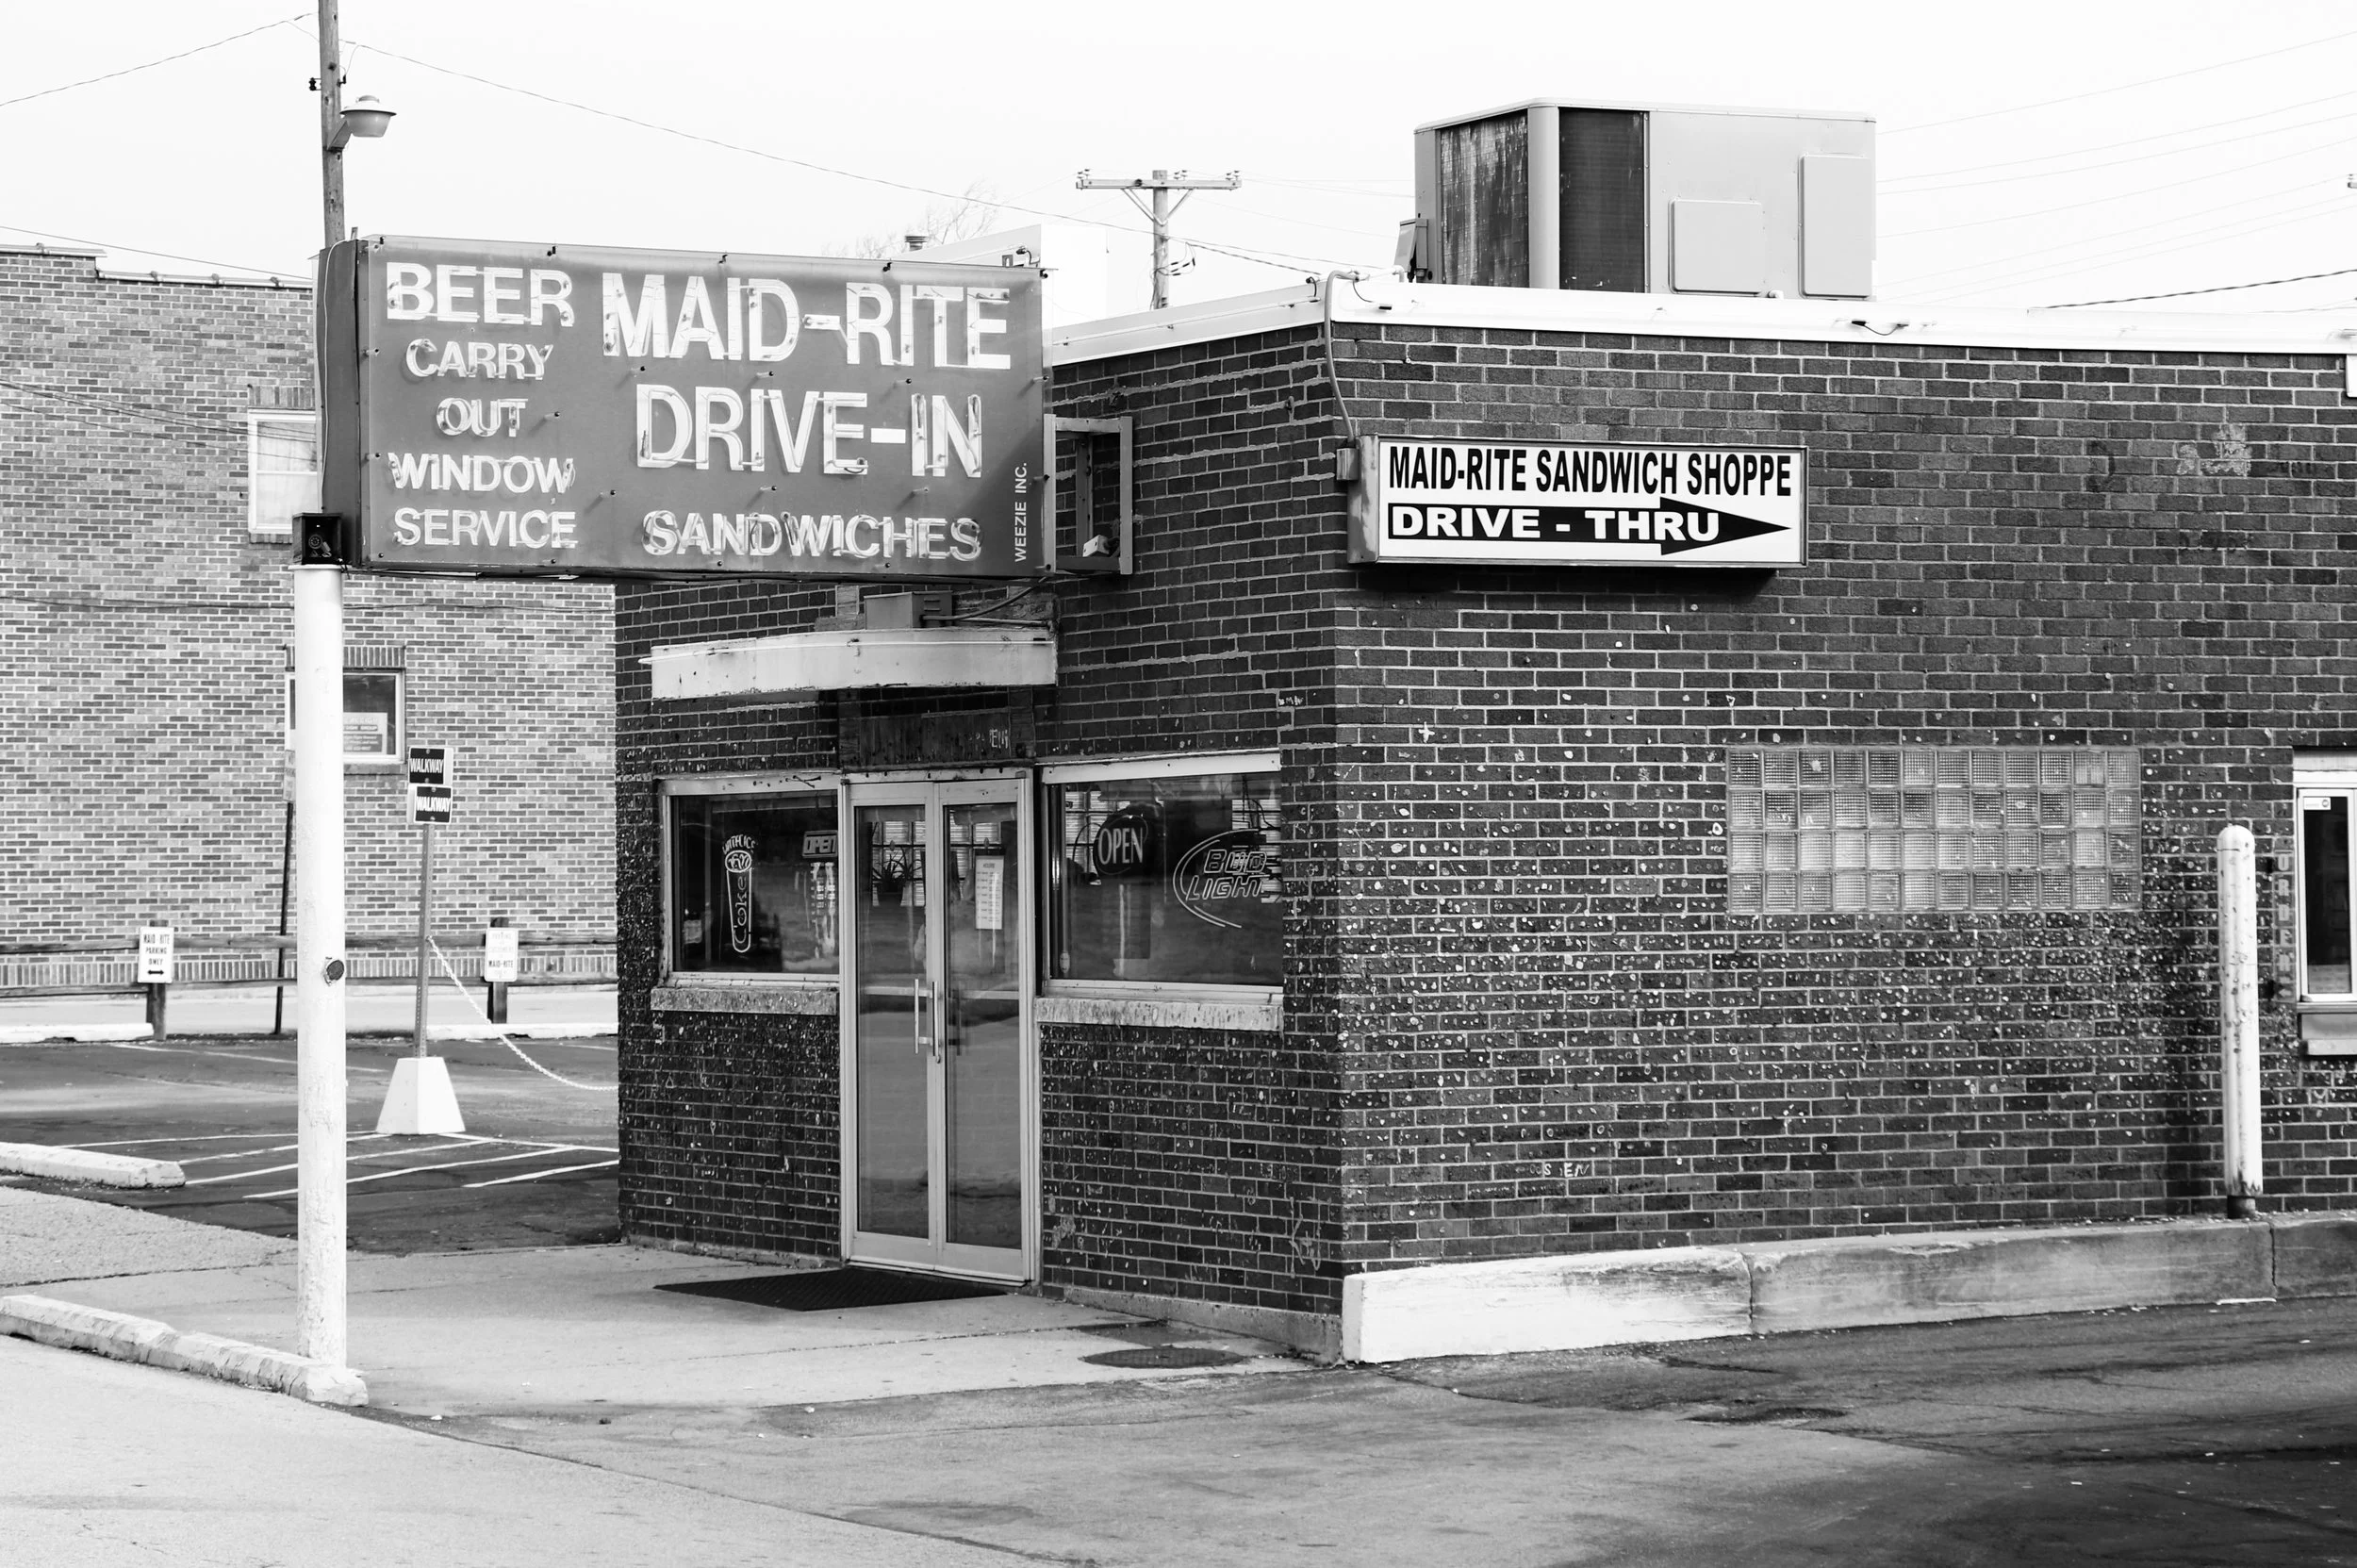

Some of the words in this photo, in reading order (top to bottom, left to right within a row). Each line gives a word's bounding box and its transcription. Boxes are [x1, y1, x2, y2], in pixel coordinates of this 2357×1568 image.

[387, 261, 575, 327] BEER
[602, 272, 1011, 370] MAID-RITE
[405, 338, 553, 380] CARRY
[436, 397, 528, 437] OUT
[636, 383, 982, 478] DRIVE-IN
[387, 452, 576, 494] WINDOW
[1014, 462, 1028, 494] INC.
[1390, 446, 1527, 491] MAID-RITE
[1536, 449, 1677, 494] SANDWICH
[1687, 453, 1791, 496] SHOPPE
[392, 507, 579, 550] SERVICE
[641, 510, 983, 563] SANDWICHES
[1014, 502, 1027, 562] WEEZIE
[1392, 505, 1541, 538] DRIVE
[1584, 510, 1720, 542] THRU
[408, 758, 444, 773] WALKWAY
[416, 796, 451, 812] WALKWAY
[803, 834, 836, 853] OPEN
[1097, 827, 1144, 865] OPEN
[1204, 849, 1267, 873] BUD
[1185, 874, 1271, 900] LIGHT
